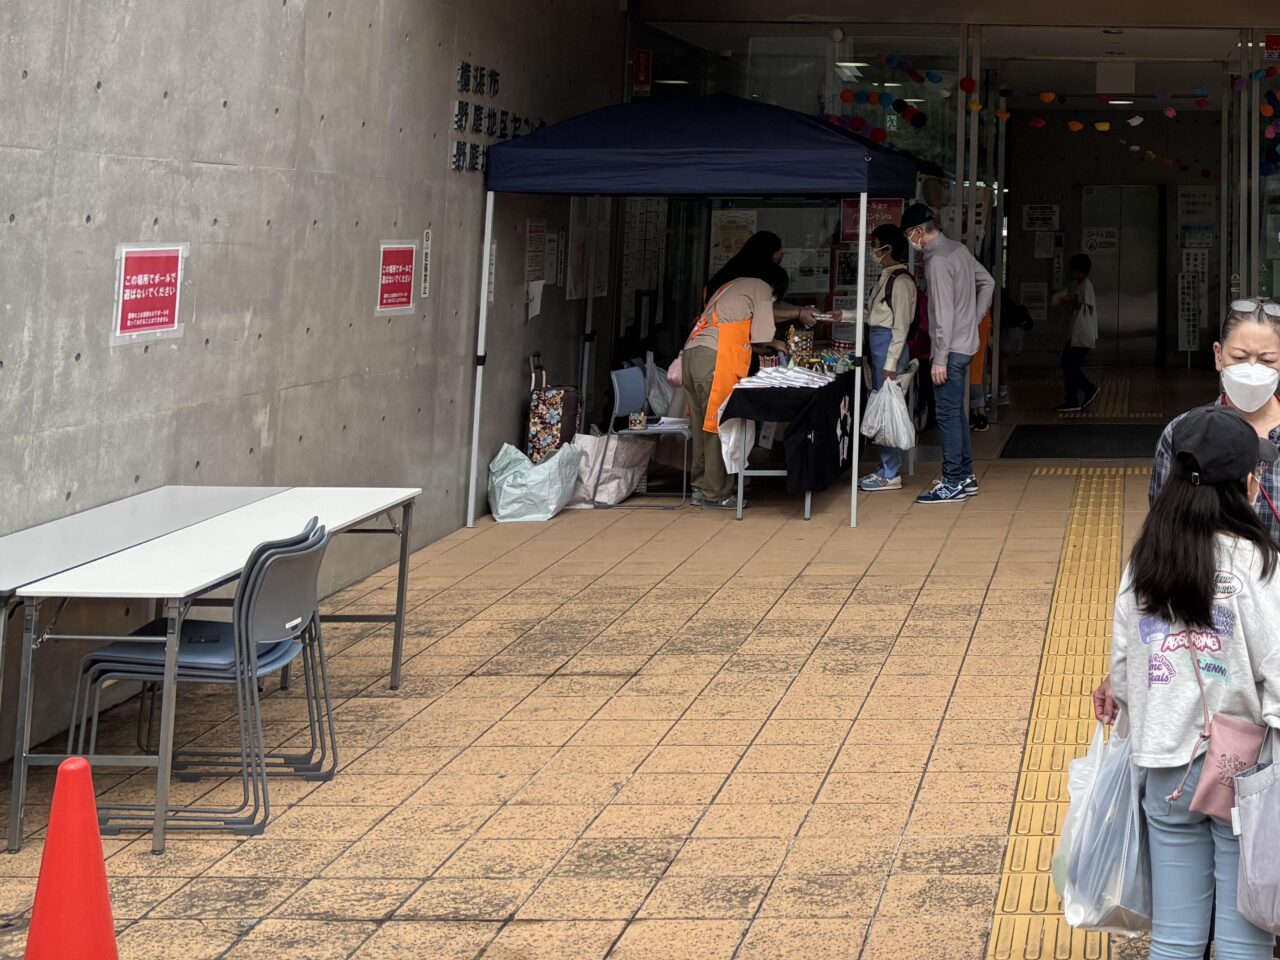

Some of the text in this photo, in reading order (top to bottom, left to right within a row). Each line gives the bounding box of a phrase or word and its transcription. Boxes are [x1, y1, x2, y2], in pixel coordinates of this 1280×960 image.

[454, 100, 546, 139] 野庭地区セン
[125, 272, 177, 286] この場所でボールで
[123, 286, 175, 300] 遊ばないでください
